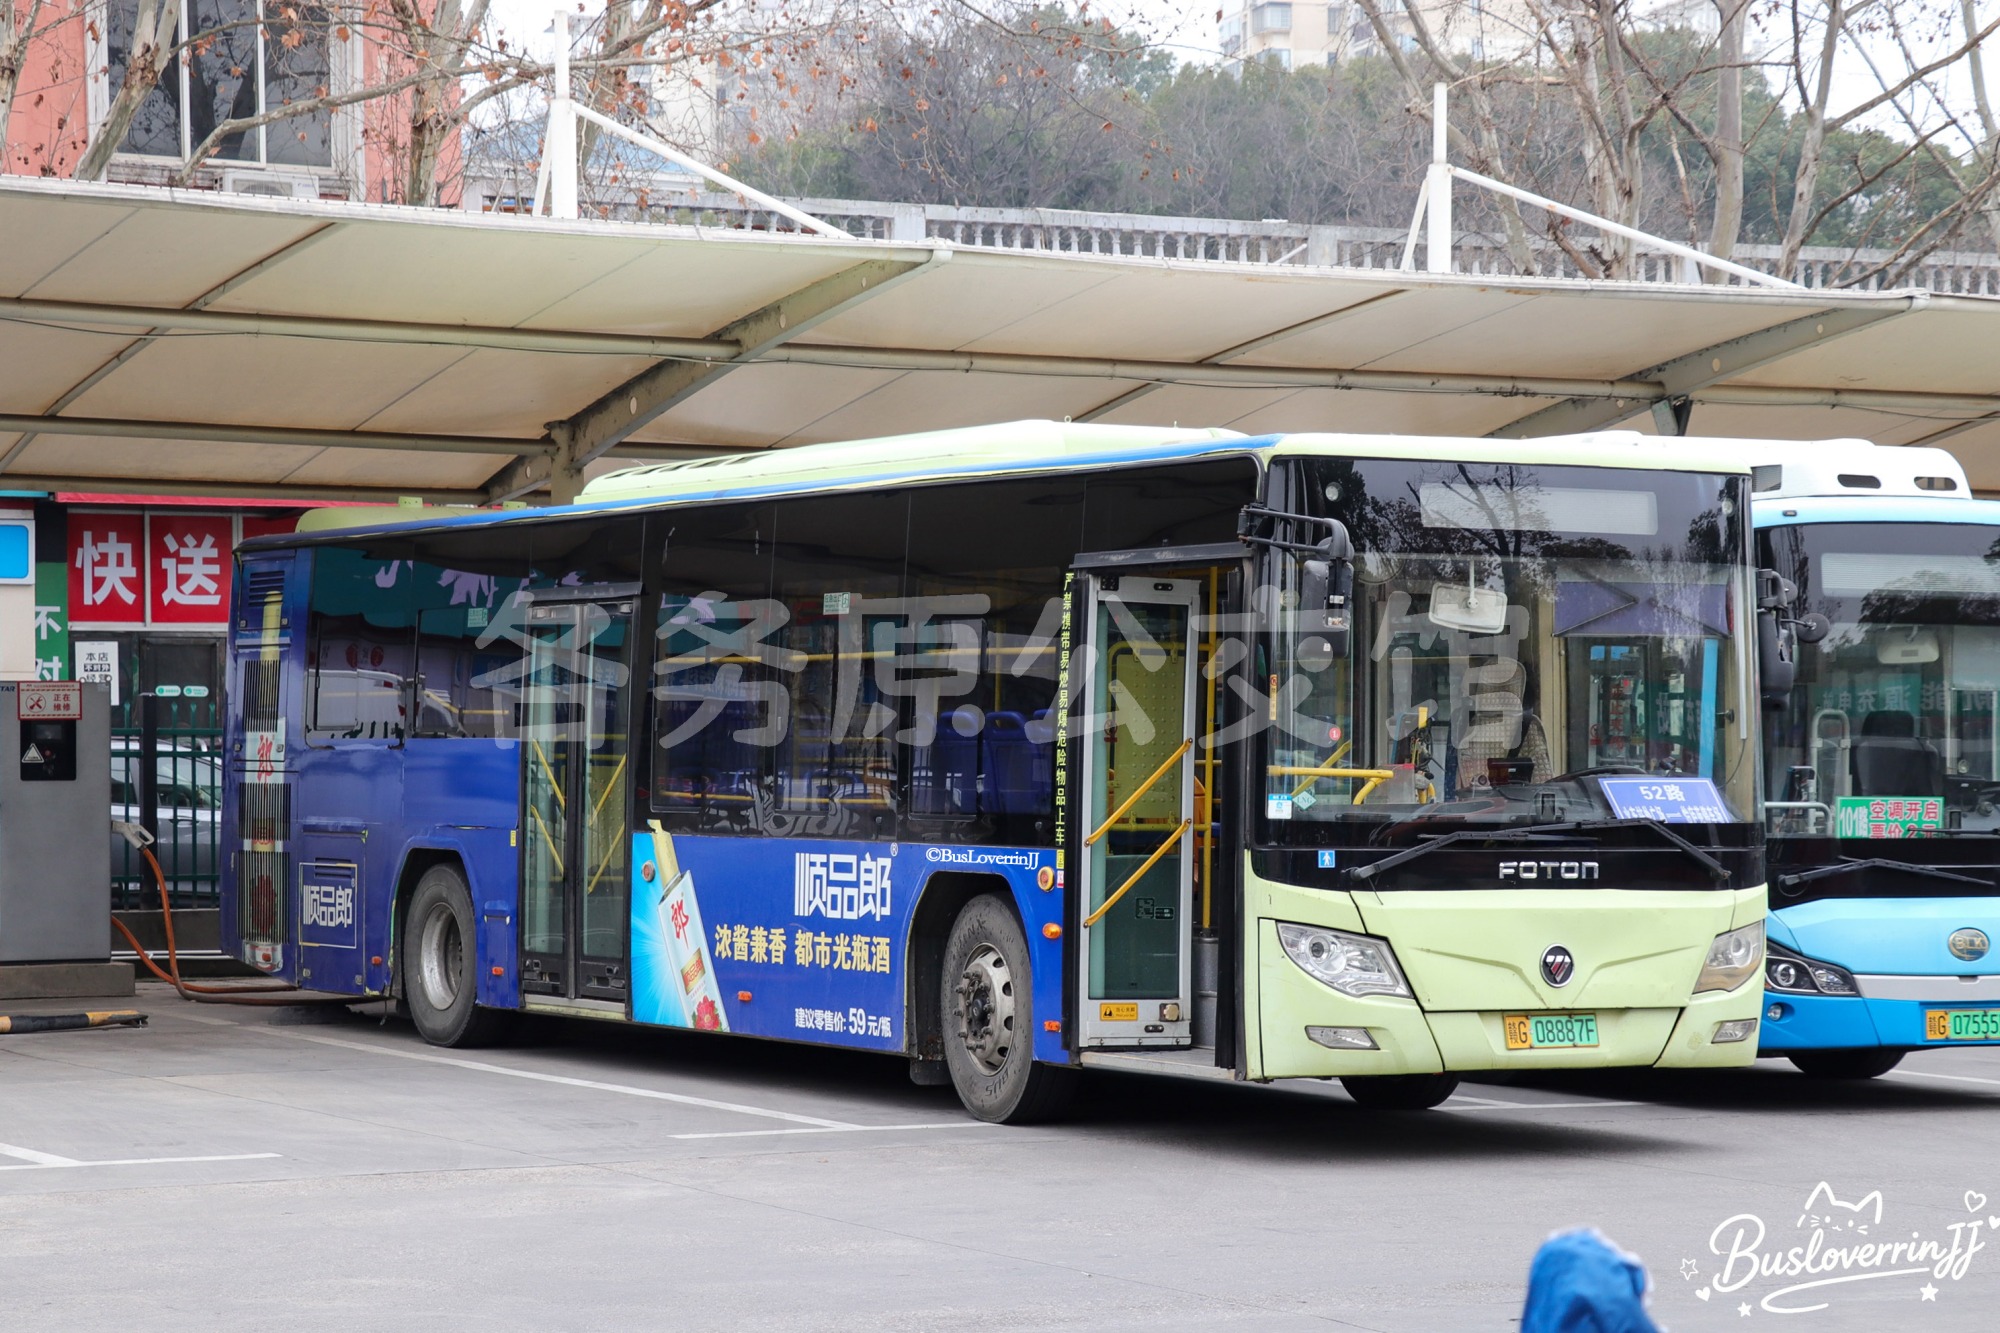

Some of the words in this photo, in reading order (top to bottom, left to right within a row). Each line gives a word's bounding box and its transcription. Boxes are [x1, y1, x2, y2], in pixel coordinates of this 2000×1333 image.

[76, 531, 222, 607] 快送
[85, 652, 109, 662] 本店
[53, 693, 71, 702] 正在
[1639, 784, 1686, 802] 52路
[1869, 800, 1940, 820] 空调开启
[1499, 861, 1600, 880] FOTON
[794, 852, 892, 922] 顺品郎
[714, 924, 787, 965] 浓酱兼香
[794, 930, 891, 974] 都市光瓶酒
